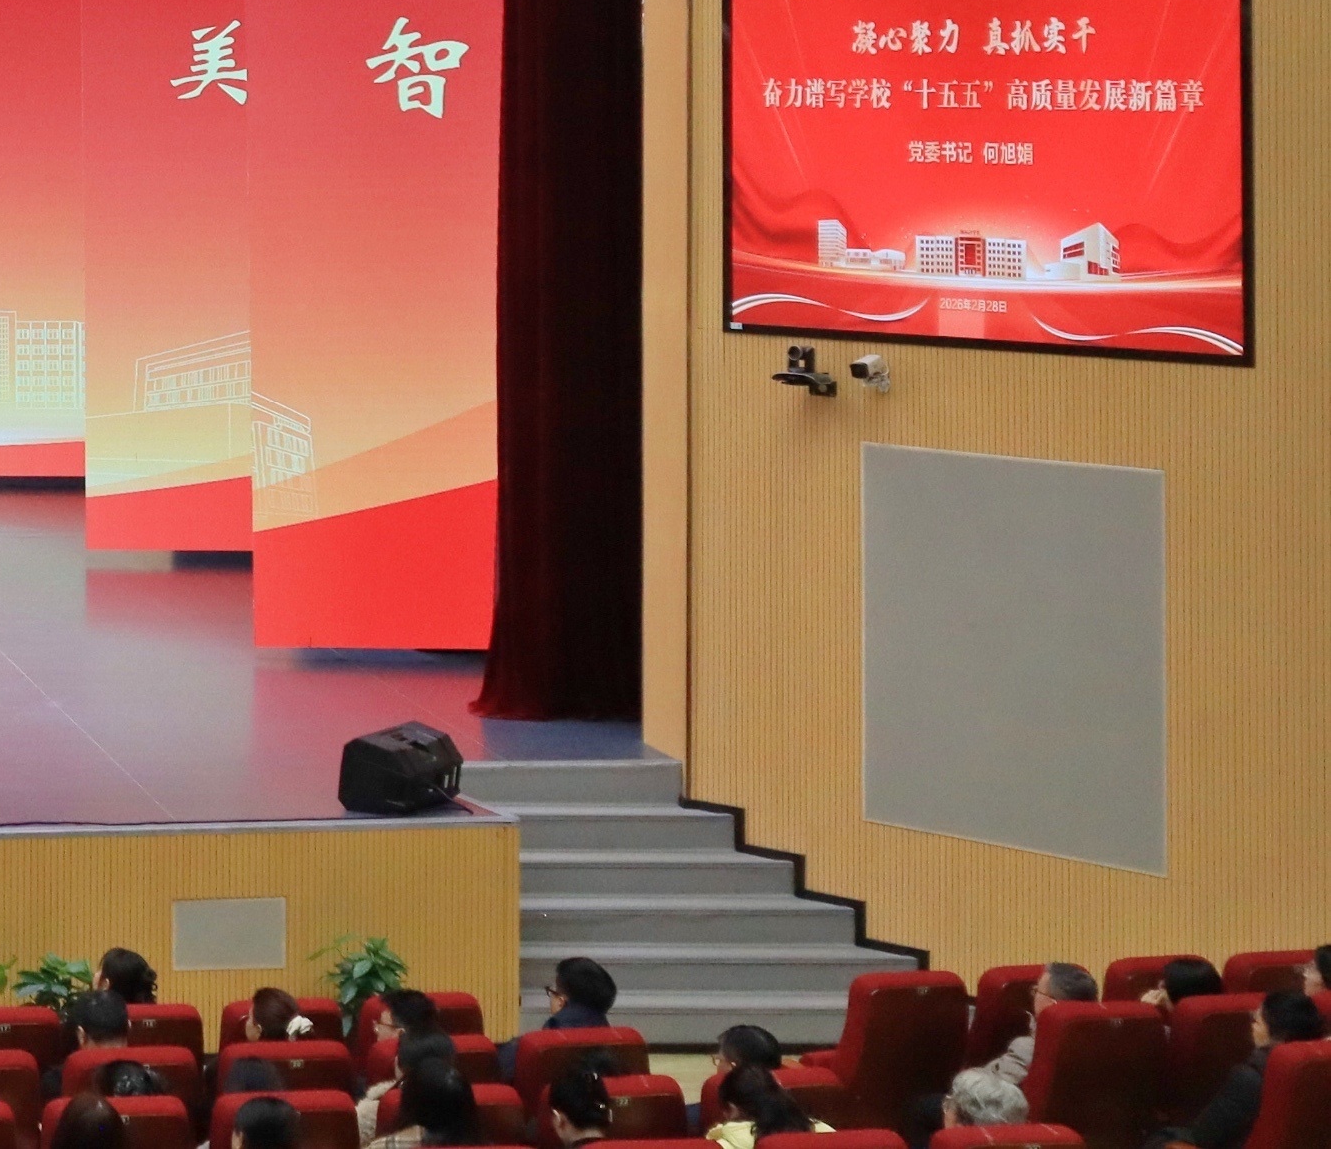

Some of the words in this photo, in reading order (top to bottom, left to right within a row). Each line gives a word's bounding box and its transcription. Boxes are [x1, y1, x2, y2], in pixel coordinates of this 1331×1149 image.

[851, 18, 960, 56] 凝心聚力
[982, 16, 1097, 56] 真抓实干
[908, 140, 974, 164] 党委书记
[982, 141, 1034, 166] 何旭娟
[939, 297, 1008, 313] 2026年2月28日
